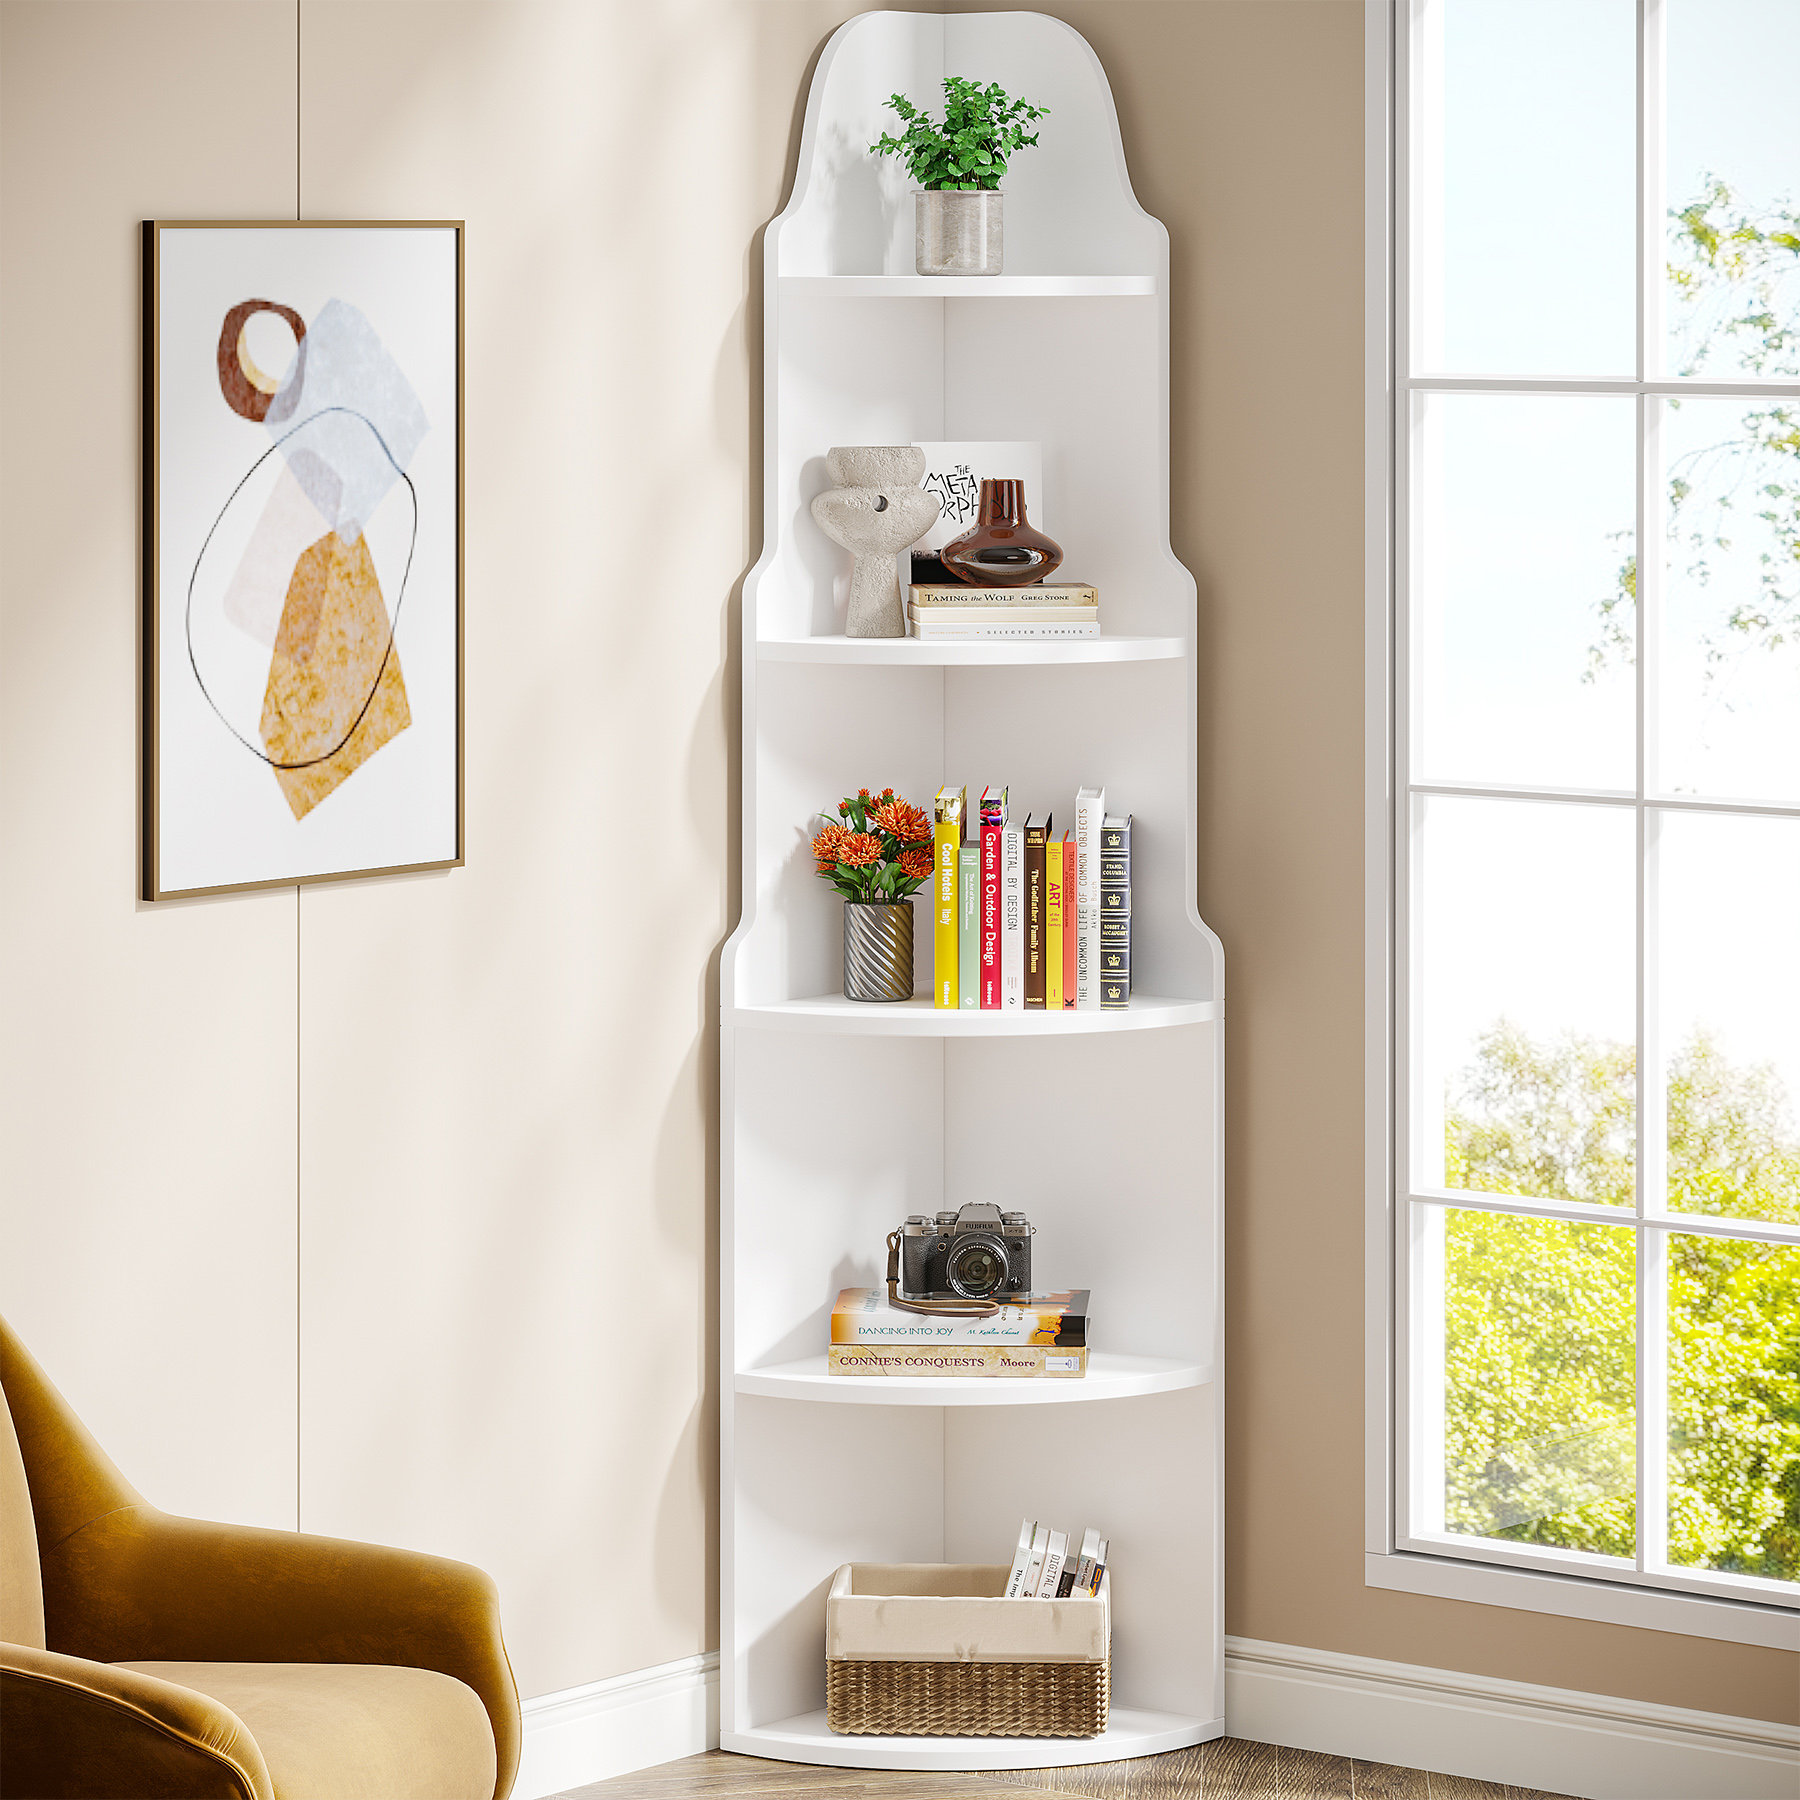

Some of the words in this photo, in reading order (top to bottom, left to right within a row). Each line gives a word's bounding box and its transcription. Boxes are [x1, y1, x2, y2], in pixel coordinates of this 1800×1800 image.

[955, 465, 970, 475] THE
[924, 594, 968, 602] TAMING
[984, 594, 1014, 602] WOLF
[1079, 808, 1088, 847] OBJECTS
[942, 843, 953, 866] Cool
[986, 833, 996, 870] Garden
[1008, 833, 1017, 871] DIGITAL
[986, 873, 996, 881] &
[1031, 870, 1039, 884] The
[1079, 853, 1087, 886] COMMON
[942, 869, 953, 902] Hotels
[1008, 878, 1017, 888] BY
[986, 884, 996, 929] Outdoor
[1031, 886, 1039, 922] Godfather
[1049, 882, 1060, 908] ART
[1079, 892, 1087, 903] OF
[940, 908, 951, 925] Italy
[1008, 895, 1017, 930] DESIGN
[1079, 909, 1087, 930] LIFE
[1030, 924, 1039, 949] Family
[983, 932, 996, 966] Design
[1079, 936, 1087, 981] UNCOMMON
[1031, 950, 1039, 973] Album
[1079, 987, 1087, 1002] THE
[858, 1327, 907, 1335] DANCING
[935, 1328, 954, 1336] JOY
[840, 1357, 902, 1366] CONNIE'S
[905, 1358, 985, 1368] CONQUESTS
[1000, 1358, 1035, 1367] Moore
[1014, 1570, 1023, 1582] The
[1043, 1554, 1060, 1587] DIGITAL
